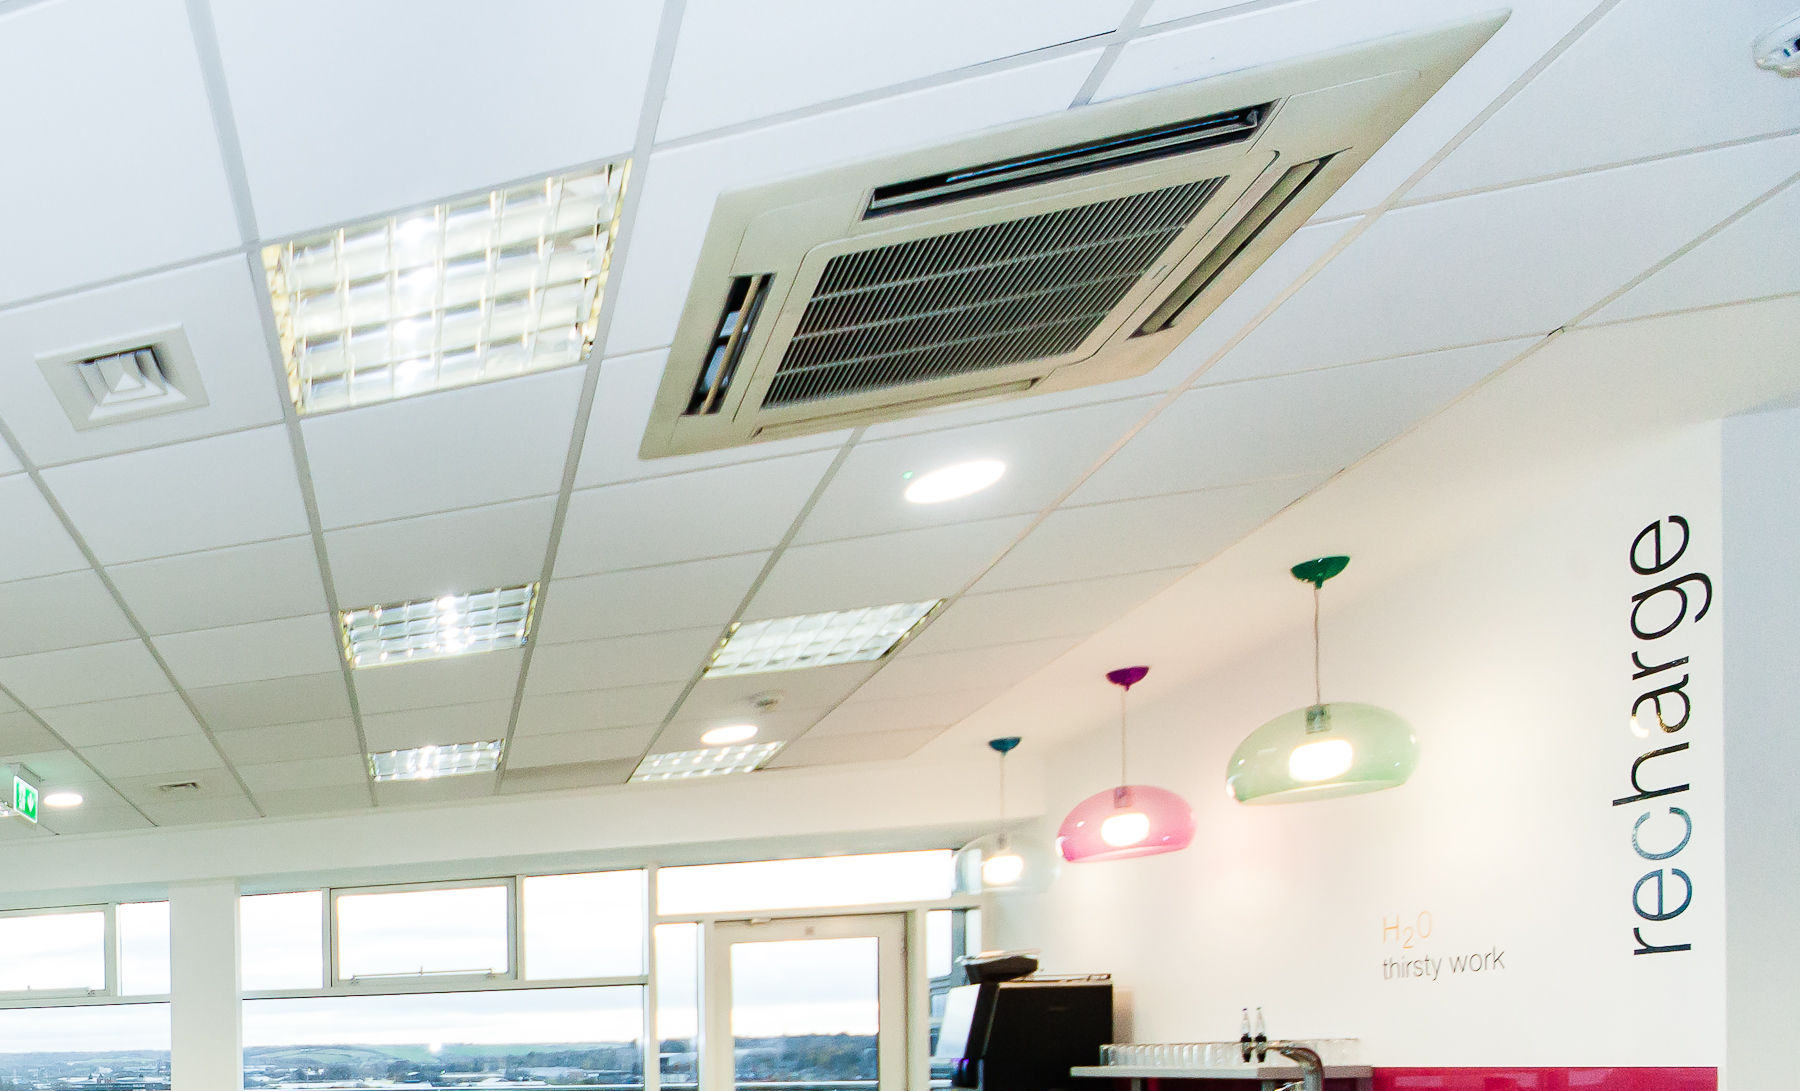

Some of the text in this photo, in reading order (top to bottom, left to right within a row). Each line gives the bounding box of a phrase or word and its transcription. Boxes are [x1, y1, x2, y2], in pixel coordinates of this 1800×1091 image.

[1612, 514, 1713, 956] recharge
[1382, 945, 1506, 982] thirsty work
